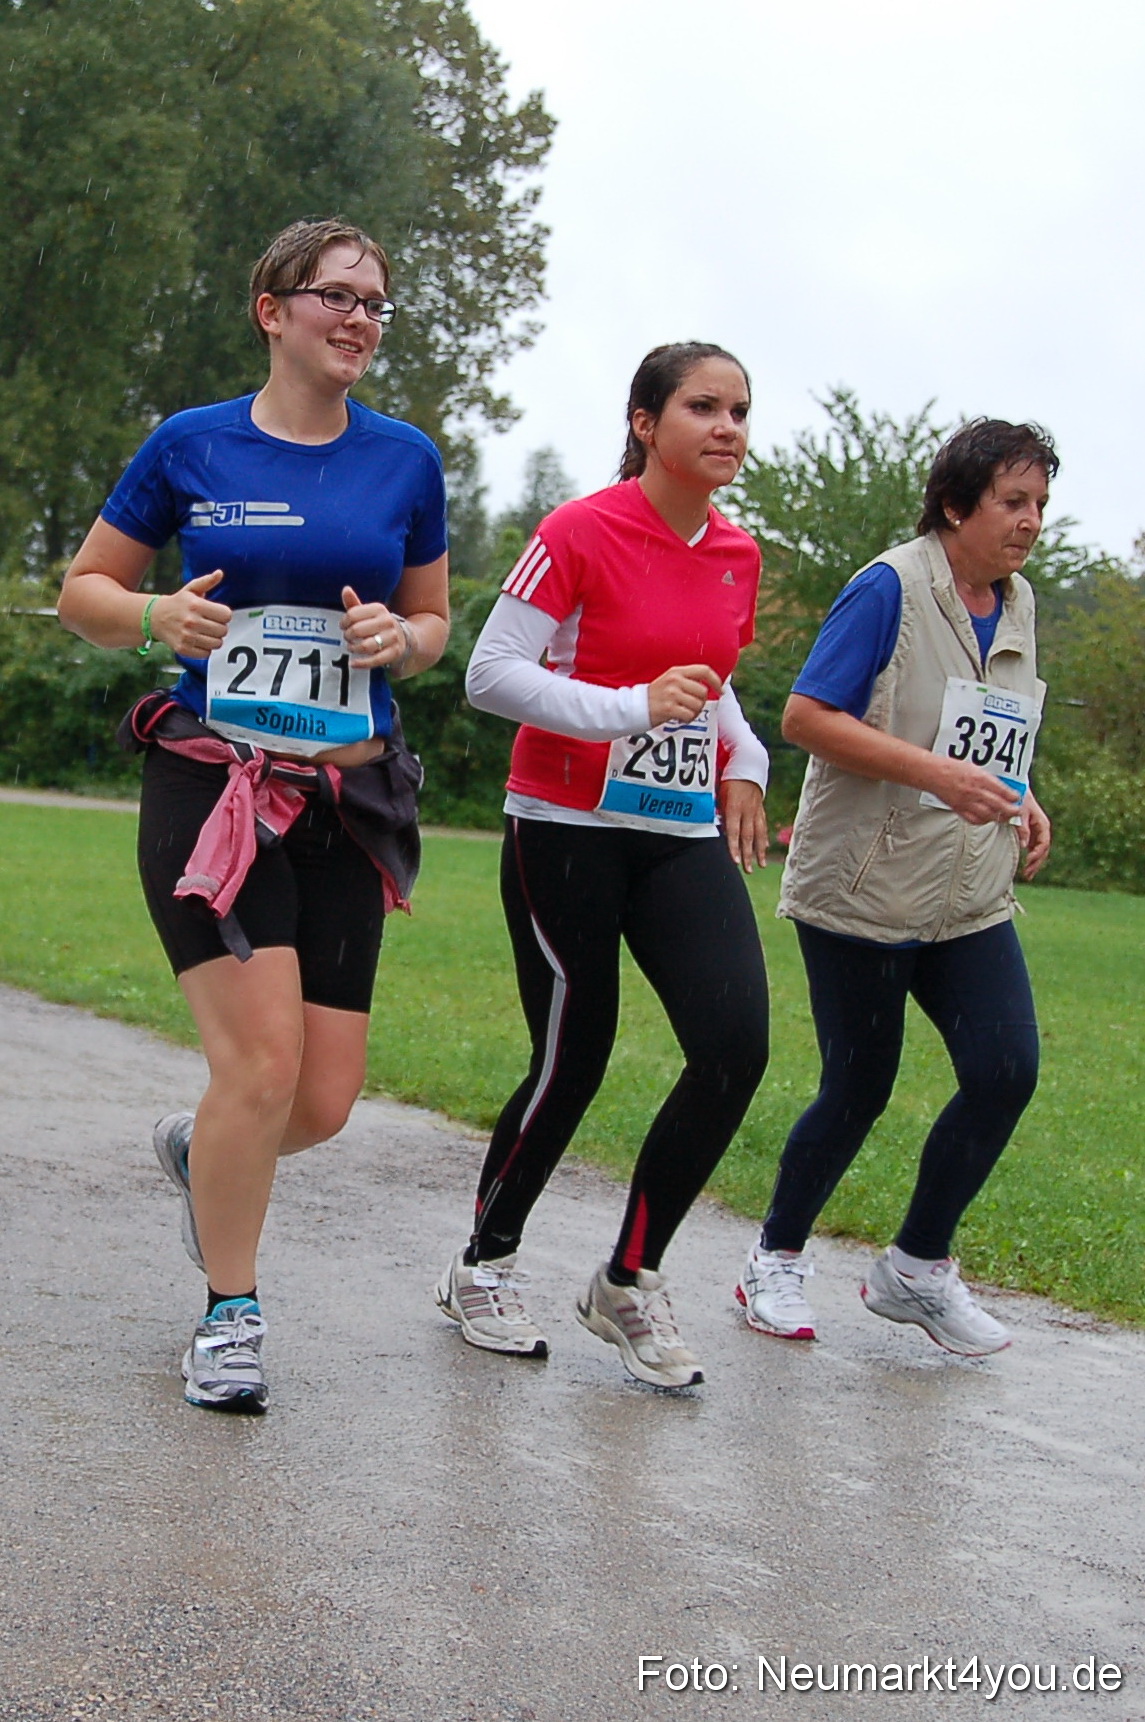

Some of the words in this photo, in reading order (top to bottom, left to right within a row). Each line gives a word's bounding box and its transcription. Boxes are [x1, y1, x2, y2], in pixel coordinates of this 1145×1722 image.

[263, 614, 327, 633] BOCK
[227, 645, 350, 707] 2711
[984, 695, 1020, 713] BOCK
[255, 706, 327, 736] Sophia
[622, 733, 711, 787] 2955
[948, 716, 1029, 776] 3341
[638, 792, 694, 817] Verena
